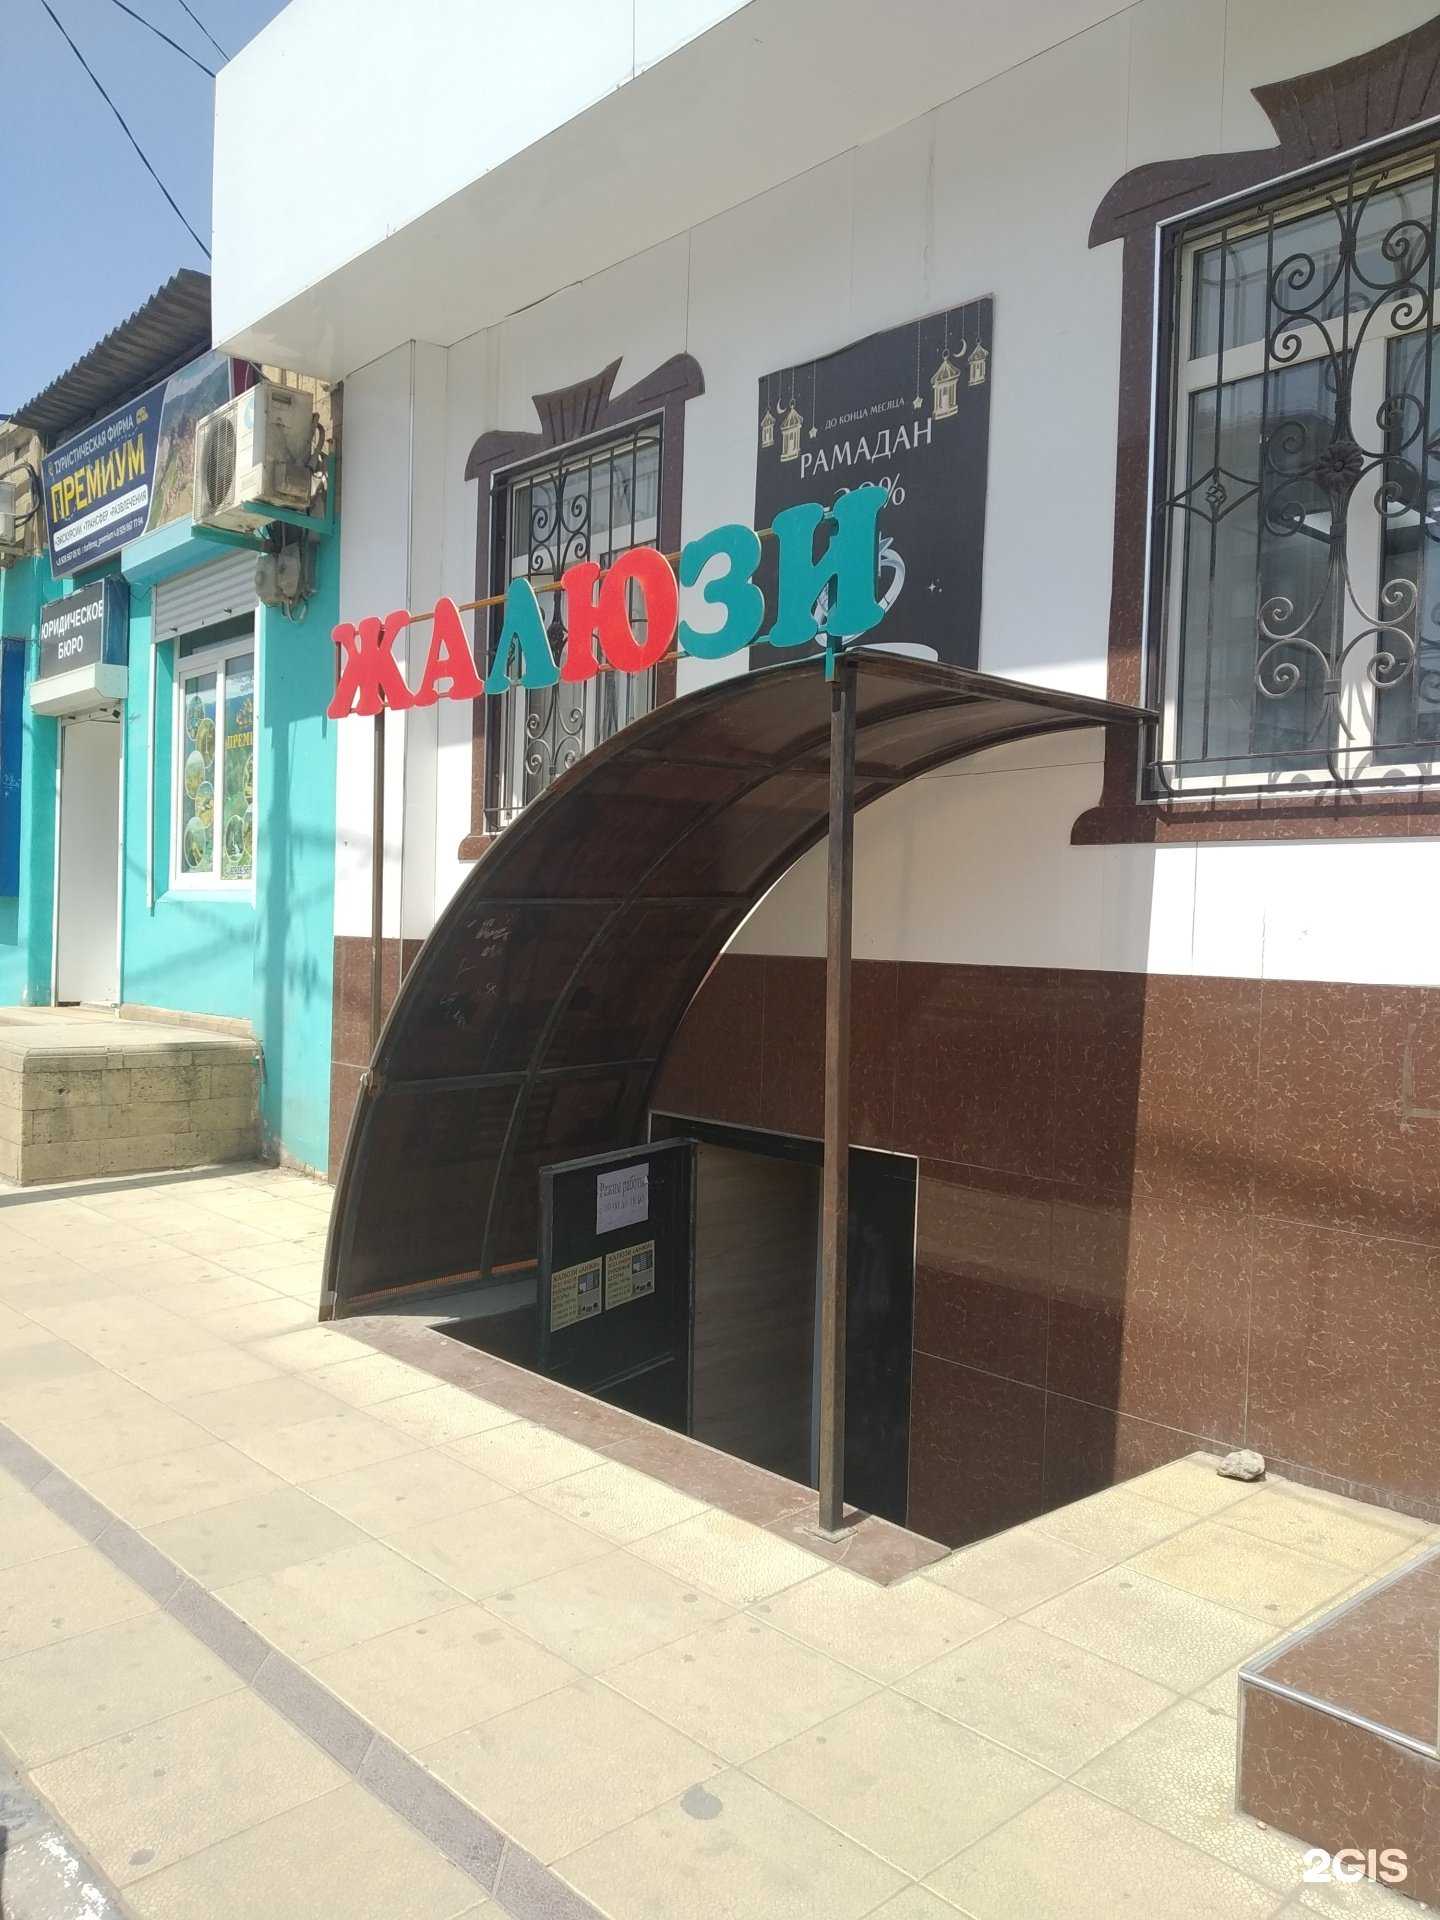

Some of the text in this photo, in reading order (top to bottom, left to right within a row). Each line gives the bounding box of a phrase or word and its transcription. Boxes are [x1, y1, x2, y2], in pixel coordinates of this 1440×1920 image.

[825, 397, 905, 430] ДО КОНЦА МЕСЯЦА
[54, 414, 134, 473] ТУРИСТИЧЕСКАЯ ФИРМА
[800, 417, 933, 480] РАМАДАН
[50, 433, 146, 524] ПРЕМИУМ
[41, 599, 104, 640] ЮРИДИЧЕСКОЕ
[327, 486, 889, 720] ЖАЛЮЗИ
[58, 635, 83, 659] БЮРО
